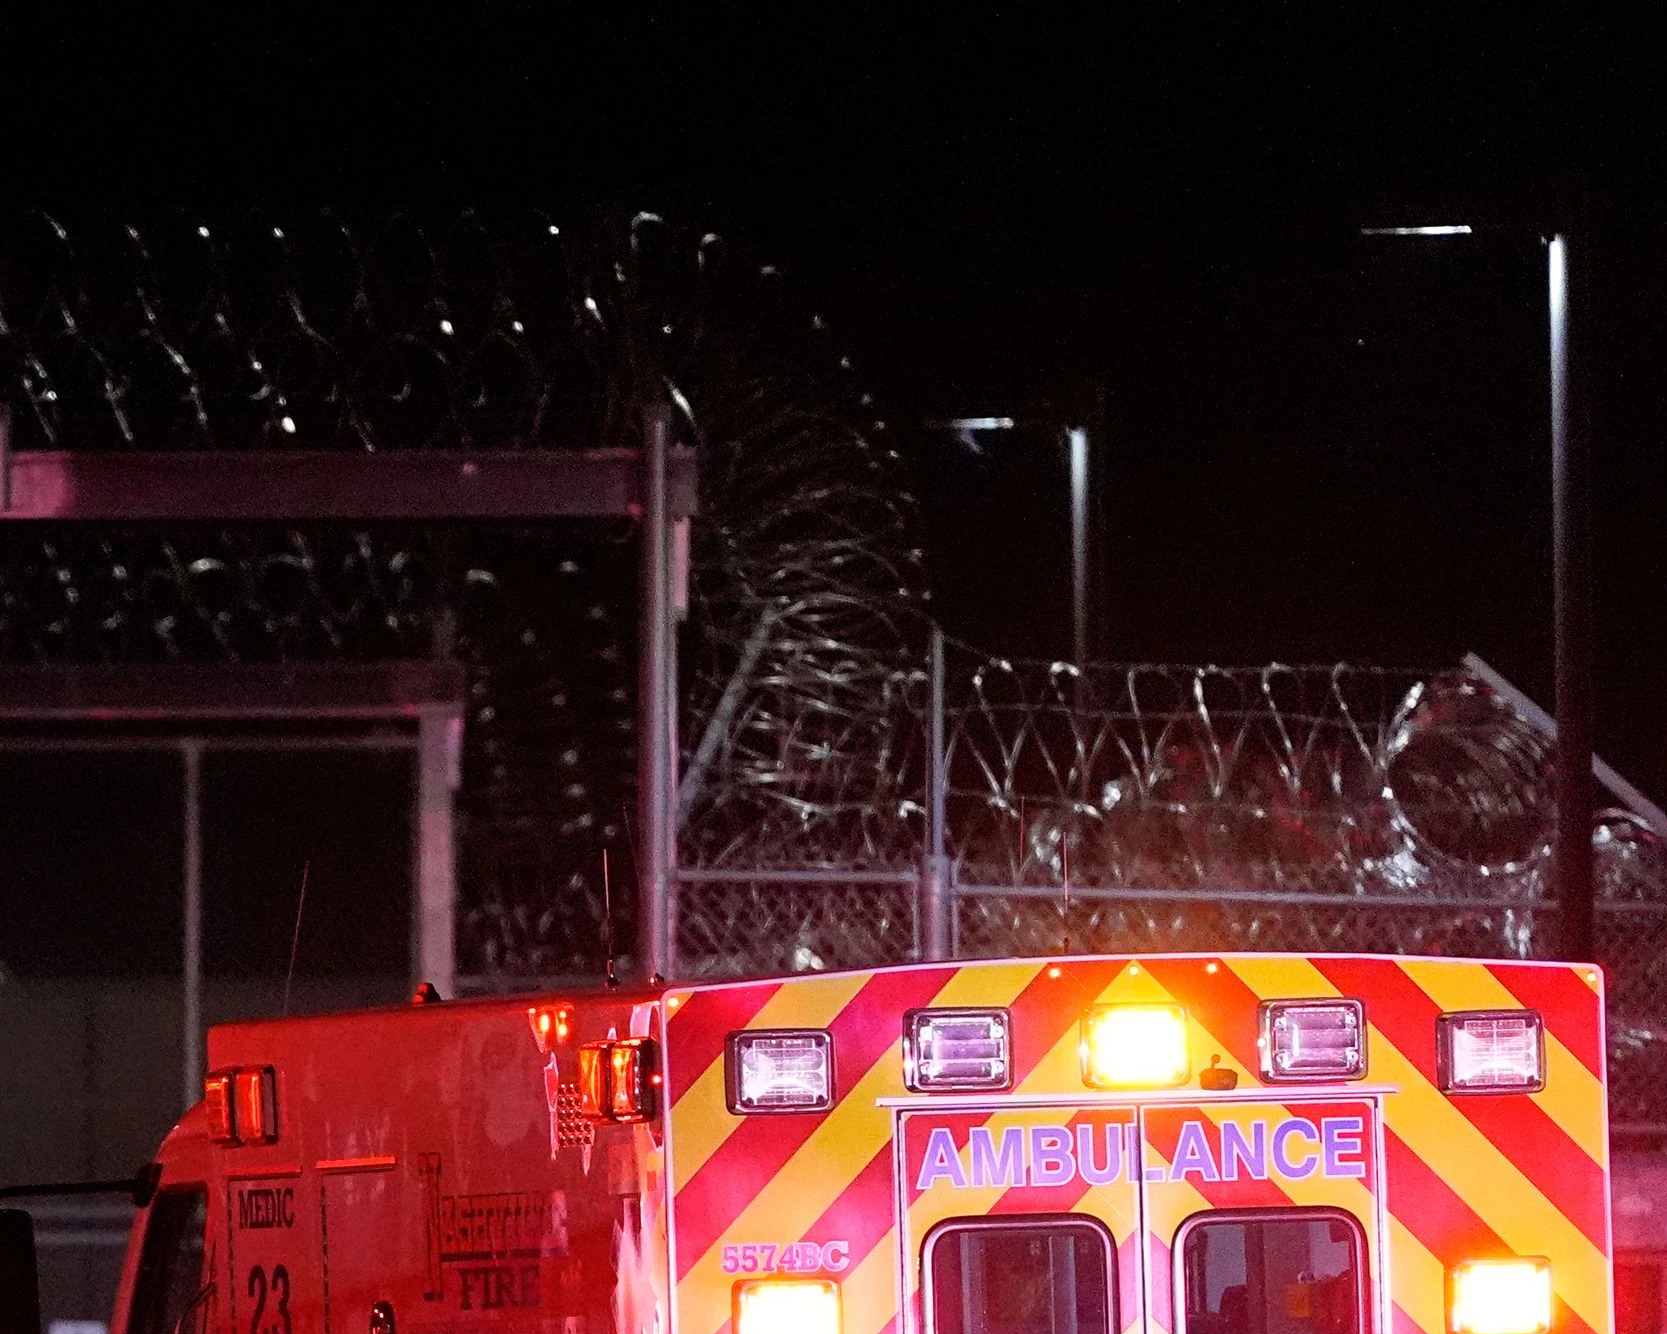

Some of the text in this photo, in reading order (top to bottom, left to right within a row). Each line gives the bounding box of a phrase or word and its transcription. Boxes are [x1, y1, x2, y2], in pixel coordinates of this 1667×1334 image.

[916, 1117, 1367, 1191] AMBULANCE
[238, 1187, 295, 1230] MEDIC
[722, 1241, 850, 1274] 5574BC
[459, 1265, 543, 1311] FIRE
